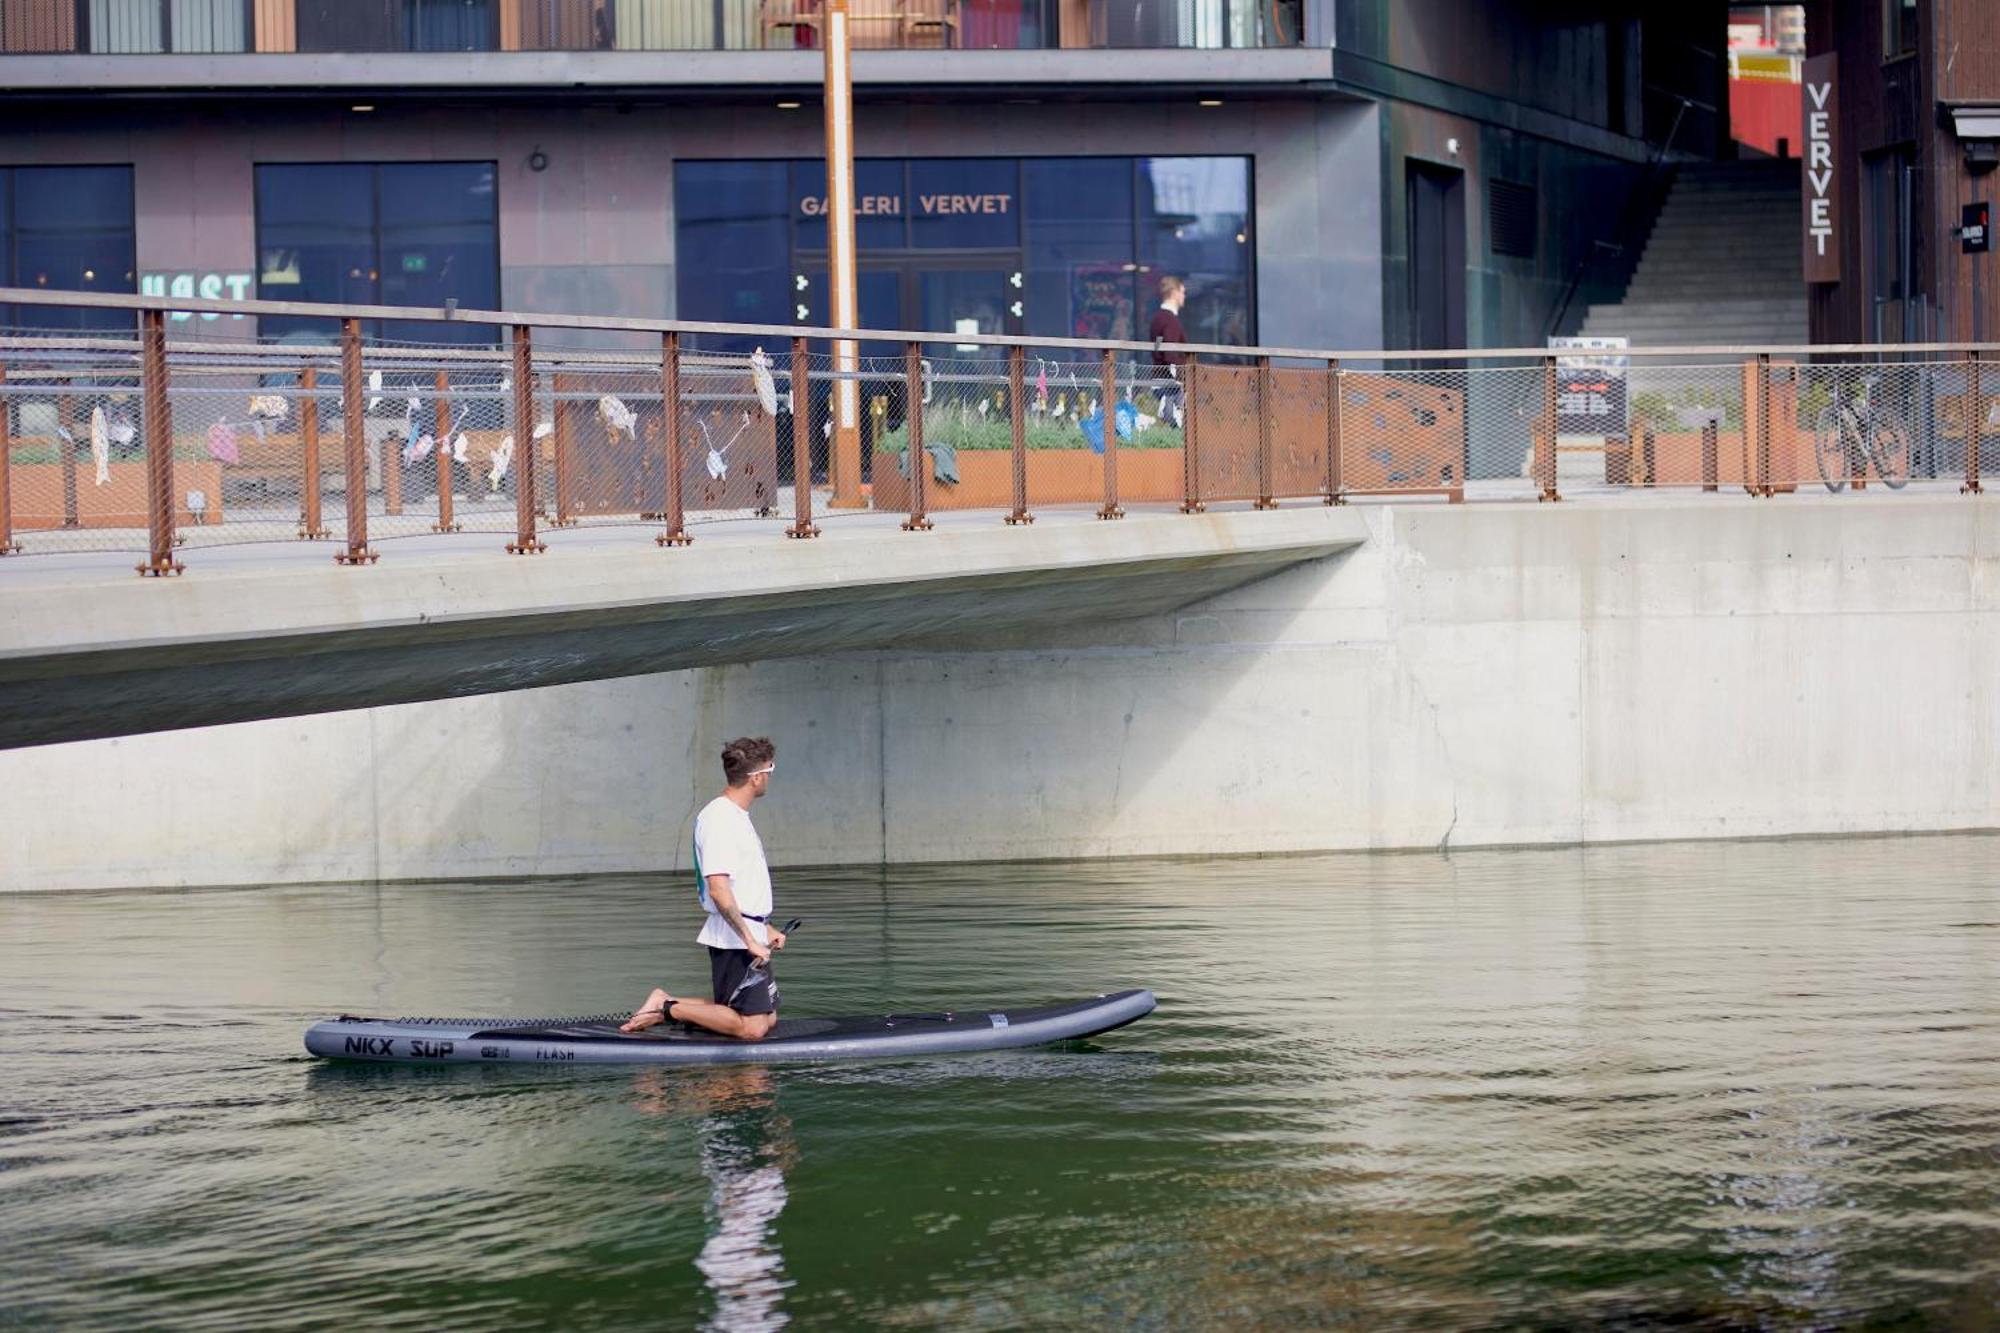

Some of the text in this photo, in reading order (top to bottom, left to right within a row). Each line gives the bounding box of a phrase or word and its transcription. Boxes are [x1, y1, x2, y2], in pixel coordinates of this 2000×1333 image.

[1807, 82, 1833, 256] VERVET
[801, 195, 1011, 215] GAERI VERVET
[345, 1036, 454, 1058] NKX SUP
[536, 1047, 574, 1060] FLASH
